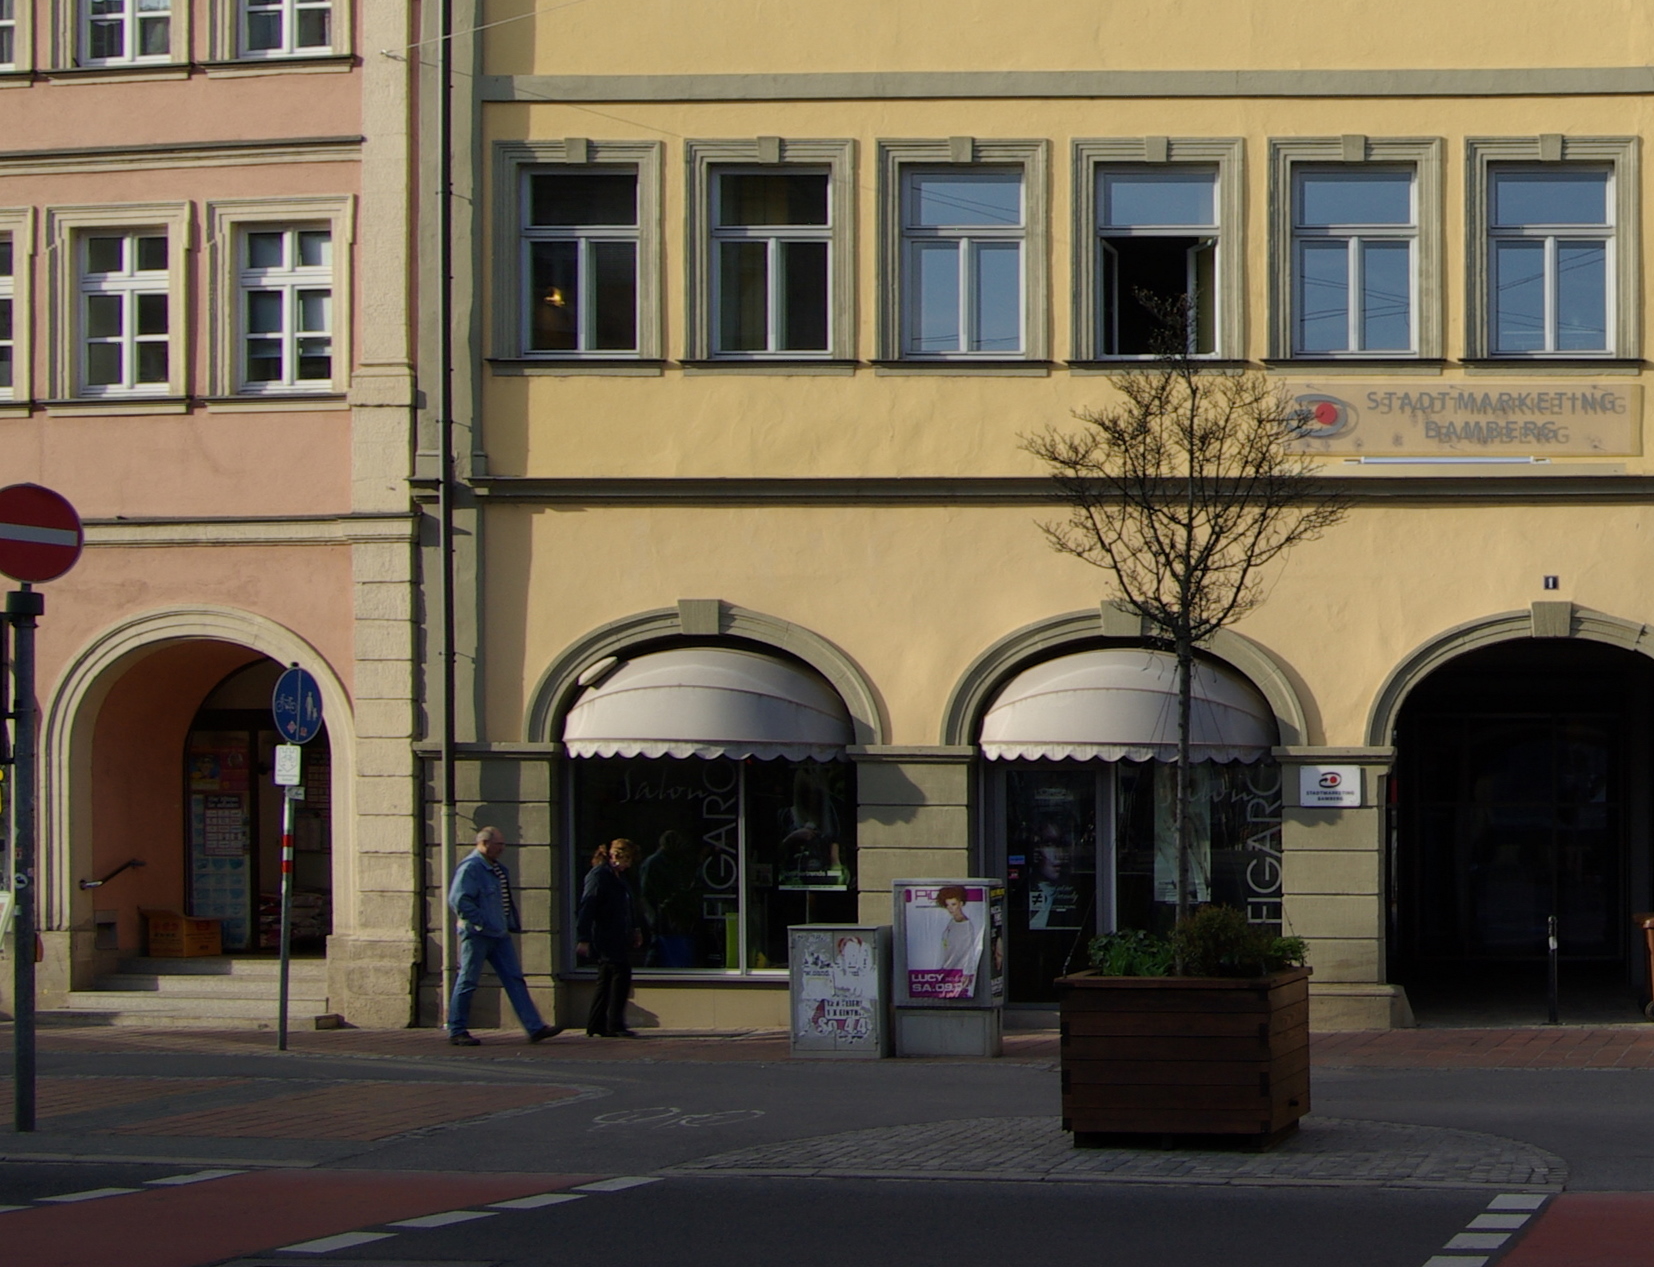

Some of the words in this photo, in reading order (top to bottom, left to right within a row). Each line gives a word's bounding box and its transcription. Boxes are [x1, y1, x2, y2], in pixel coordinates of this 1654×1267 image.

[1366, 391, 1616, 412] STADTMARKETING
[1424, 420, 1558, 440] BAMBERG
[619, 766, 708, 805] Salon
[702, 759, 738, 920] FIGARO
[911, 973, 944, 982] LUCY
